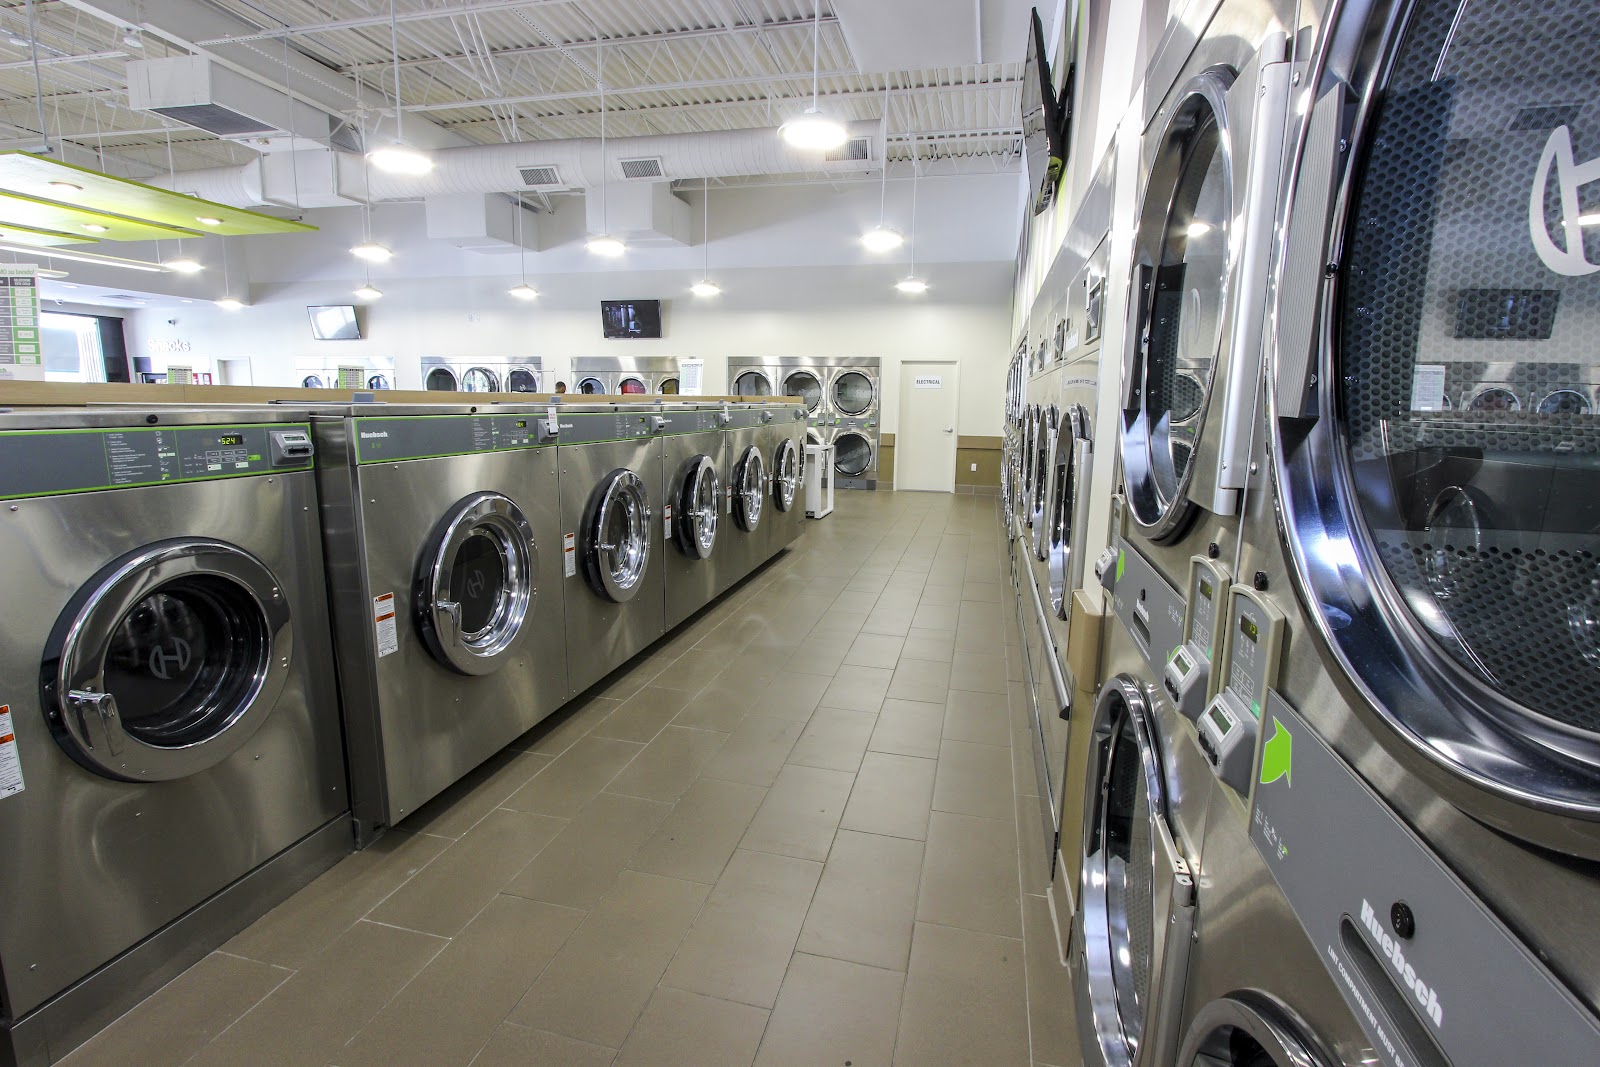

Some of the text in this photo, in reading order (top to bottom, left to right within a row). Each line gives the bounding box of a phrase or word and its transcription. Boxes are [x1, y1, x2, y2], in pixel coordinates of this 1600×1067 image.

[147, 337, 191, 352] Snacks
[360, 431, 388, 439] Huebsch
[1360, 898, 1444, 1029] Huebsch
[1327, 945, 1340, 966] LINT
[1338, 962, 1379, 1029] COMPARTMENT
[1377, 1025, 1397, 1057] MUST
